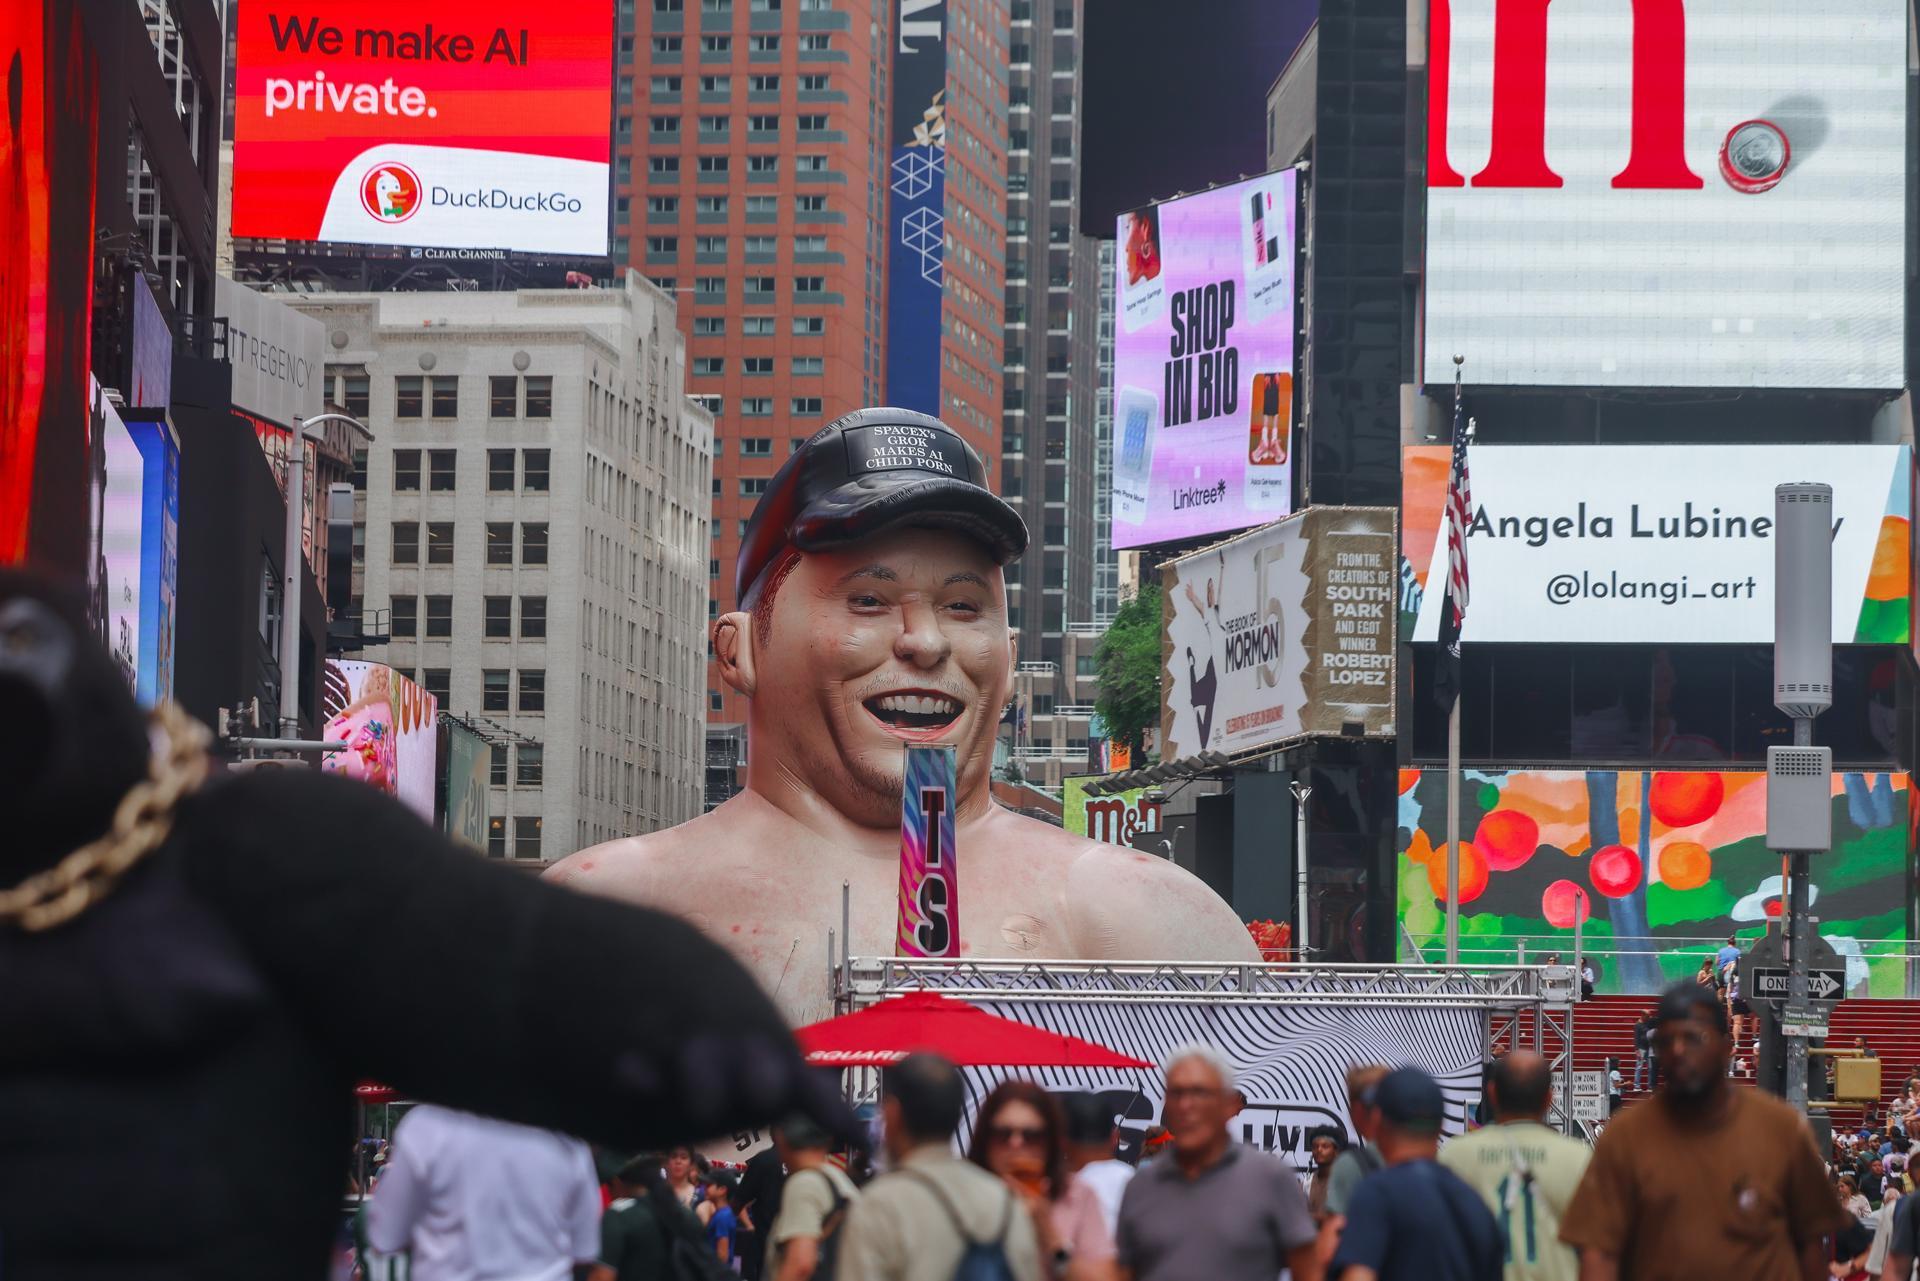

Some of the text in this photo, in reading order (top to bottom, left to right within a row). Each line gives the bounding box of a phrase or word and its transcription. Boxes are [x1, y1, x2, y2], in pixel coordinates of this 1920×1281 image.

[269, 13, 528, 66] We make AI
[265, 70, 437, 118] private.
[432, 186, 582, 213] DuckDuckGo
[425, 248, 506, 260] CLEAR CHANNEL
[1170, 279, 1236, 358] SHOP
[250, 335, 314, 392] REGENCY
[1164, 347, 1238, 428] IN BIO
[887, 435, 928, 448] GROK
[873, 446, 944, 461] MAKES AI
[866, 456, 953, 474] CHILD PORN
[1467, 502, 1613, 547] Angela
[1337, 553, 1381, 566] FROM THE
[1328, 570, 1390, 584] CREATORS OF
[1326, 586, 1391, 601] SOUTH
[1547, 571, 1757, 605] @lolangi_art
[1333, 602, 1384, 618] PARK
[1335, 621, 1381, 635] AND EGOT
[1225, 621, 1279, 674] MORMON
[1339, 637, 1377, 651] WINNER
[1323, 653, 1393, 669] ROBERT
[1329, 671, 1386, 686] LOPEZ
[805, 1050, 911, 1061] SQUARE
[1243, 1124, 1314, 1152] LIV
